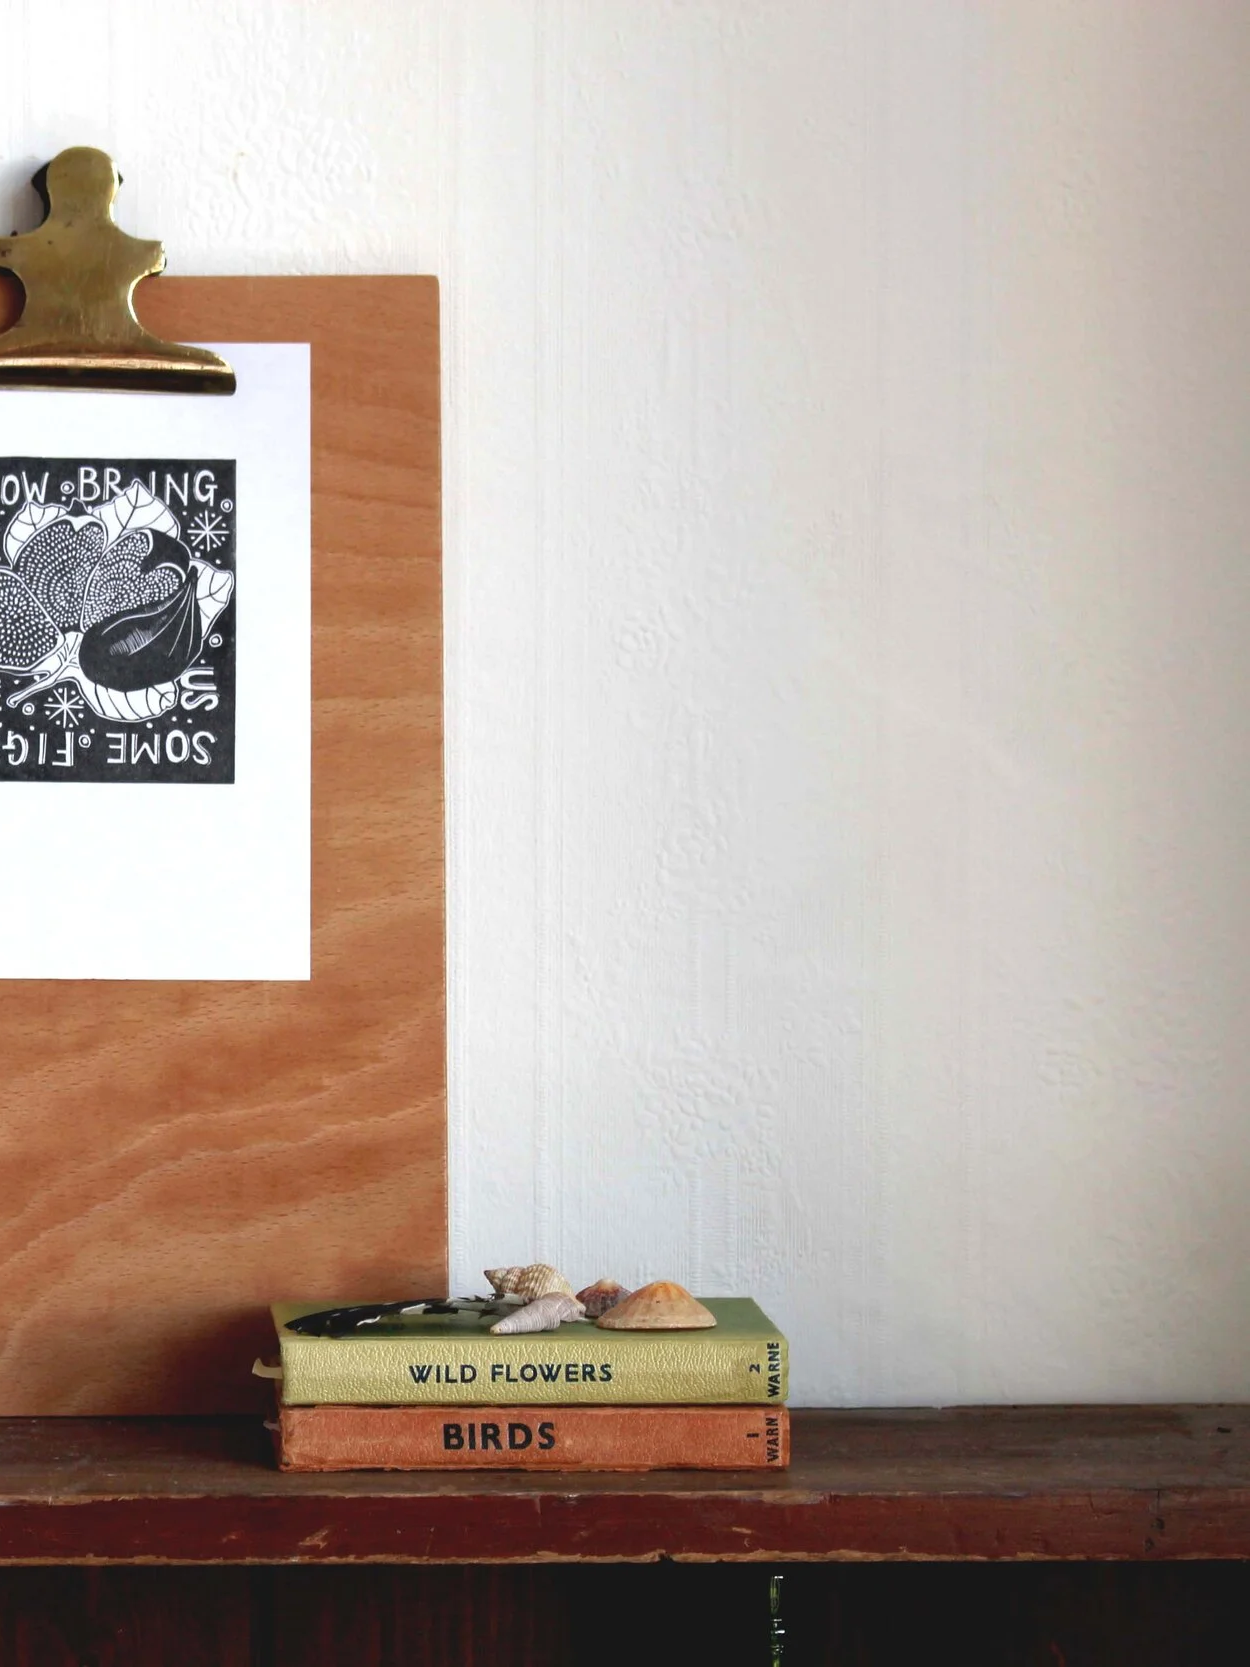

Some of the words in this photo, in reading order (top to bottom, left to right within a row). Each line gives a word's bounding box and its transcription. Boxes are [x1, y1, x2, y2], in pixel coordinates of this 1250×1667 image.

[78, 466, 218, 507] BRING
[180, 667, 219, 711] US
[106, 730, 218, 765] SOME
[409, 1364, 477, 1384] WILD
[491, 1363, 613, 1383] FLOWERS
[749, 1363, 760, 1374] 2
[767, 1342, 781, 1398] WARNE
[443, 1422, 556, 1450] BIRDS
